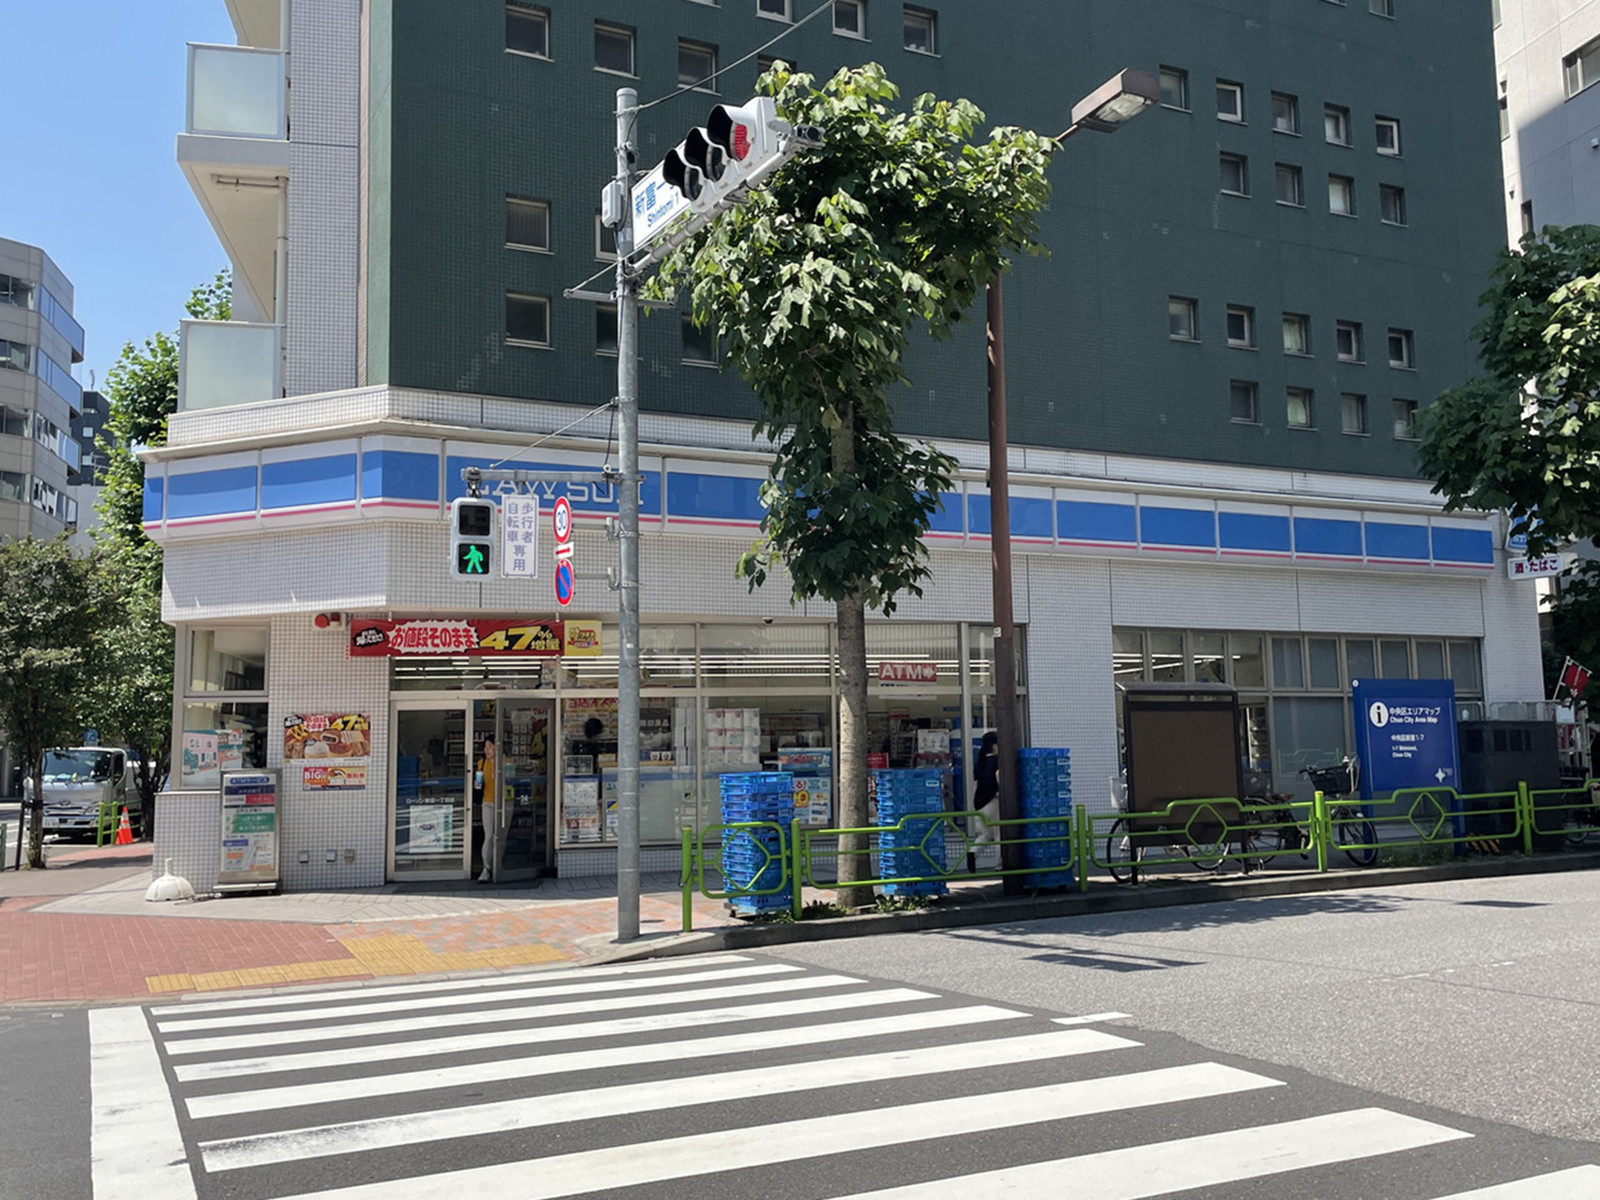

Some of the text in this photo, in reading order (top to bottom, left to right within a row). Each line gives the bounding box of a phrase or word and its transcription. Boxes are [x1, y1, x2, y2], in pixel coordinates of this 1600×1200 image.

[467, 476, 645, 505] AWSO
[507, 503, 519, 542] 自転車
[521, 503, 533, 543] 歩行者
[557, 509, 568, 531] 30
[513, 545, 526, 571] 専用
[391, 627, 476, 648] お値段そのまま
[880, 663, 922, 679] ATM
[1389, 707, 1441, 716] 中央区エリアマップ
[304, 771, 322, 780] BIG
